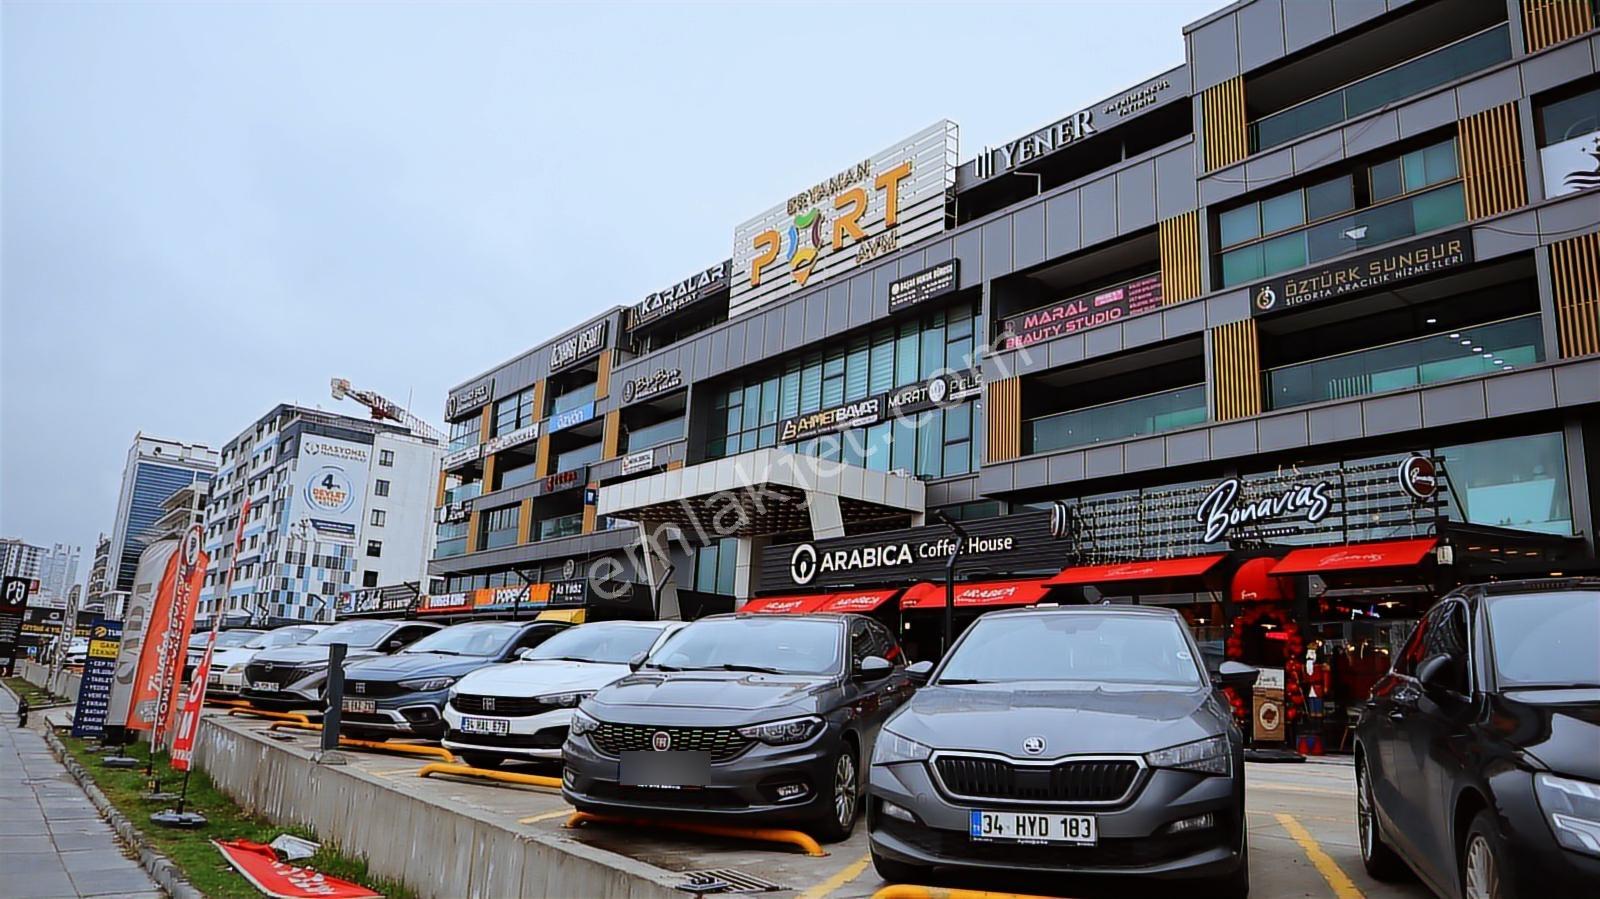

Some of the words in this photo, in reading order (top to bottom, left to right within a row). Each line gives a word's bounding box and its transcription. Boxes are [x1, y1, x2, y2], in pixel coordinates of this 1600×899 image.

[1000, 110, 1098, 170] YENER
[855, 229, 898, 264] AVM
[1285, 266, 1361, 297] ÖZTÜRK
[1369, 239, 1462, 276] SUNGUR
[641, 263, 725, 315] KARALAR
[1005, 324, 1063, 350] BEAUTY
[1065, 307, 1122, 332] STUDIO
[1024, 301, 1089, 329] MARAL
[887, 386, 928, 410] MURAT
[322, 473, 334, 490] 4
[1197, 478, 1329, 543] Bonavias
[820, 543, 913, 573] ARABICA
[968, 535, 1013, 554] House
[983, 814, 1003, 835] 34
[1015, 815, 1048, 837] HYD
